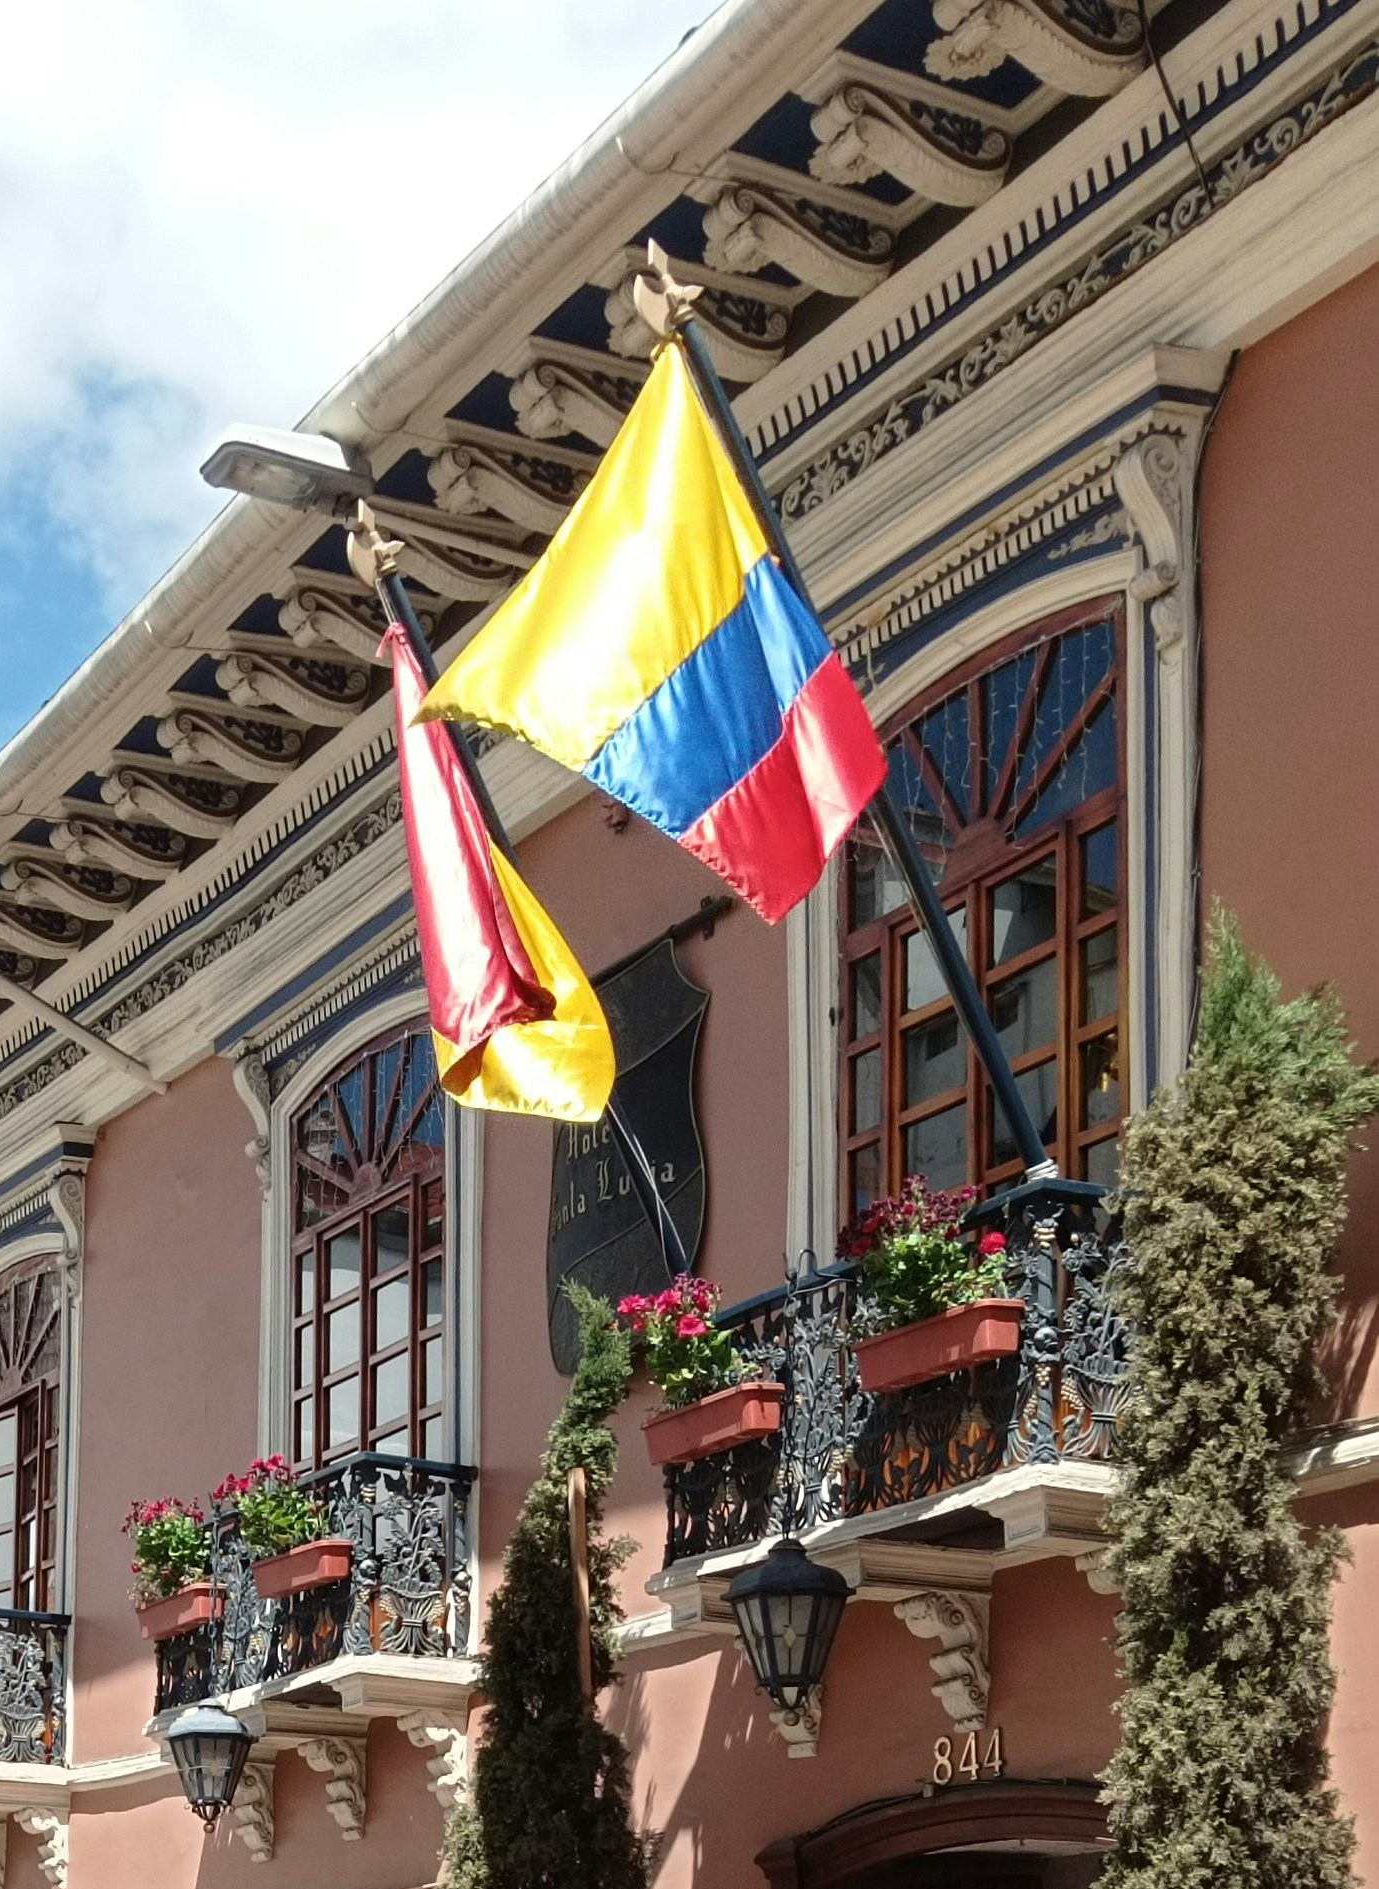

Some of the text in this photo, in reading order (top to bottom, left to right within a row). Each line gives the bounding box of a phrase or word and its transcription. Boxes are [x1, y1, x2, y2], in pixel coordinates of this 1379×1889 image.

[566, 1121, 611, 1165] Hote
[596, 1157, 676, 1203] Luia
[933, 1727, 1003, 1786] 844
